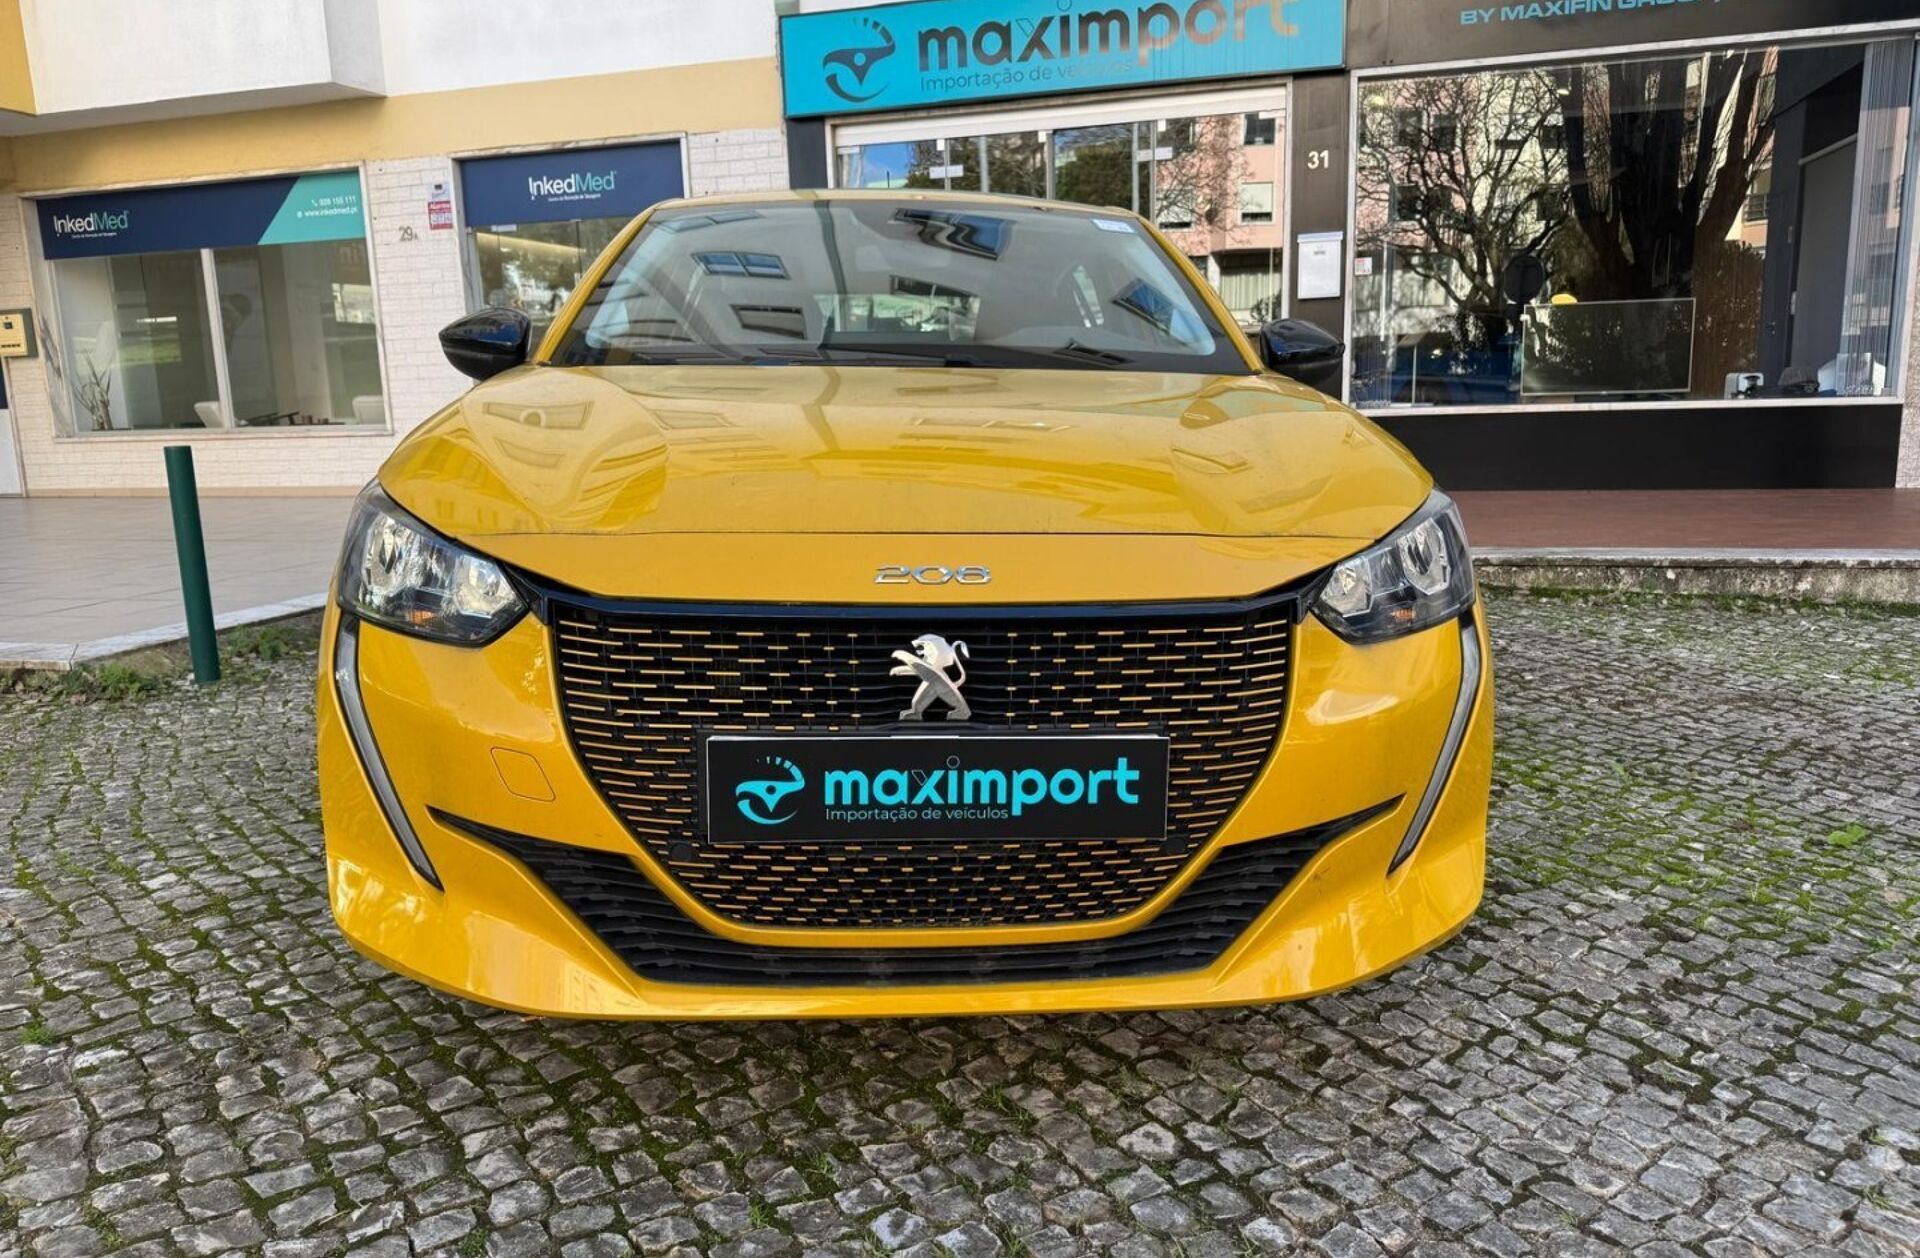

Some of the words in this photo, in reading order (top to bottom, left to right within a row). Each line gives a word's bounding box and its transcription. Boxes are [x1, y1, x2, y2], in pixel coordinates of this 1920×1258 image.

[1460, 8, 1495, 25] BY
[1500, 0, 1612, 21] MAXIFIN
[918, 0, 1299, 72] maximport
[920, 67, 1024, 93] Importação
[1029, 64, 1053, 81] de
[1307, 150, 1329, 169] 31
[528, 169, 615, 200] InkedMed
[53, 211, 129, 237] InkedMed
[875, 564, 992, 586] 208
[824, 755, 1140, 816] maximport
[826, 807, 918, 823] Importação
[921, 807, 942, 819] de
[946, 806, 1009, 819] veículos
